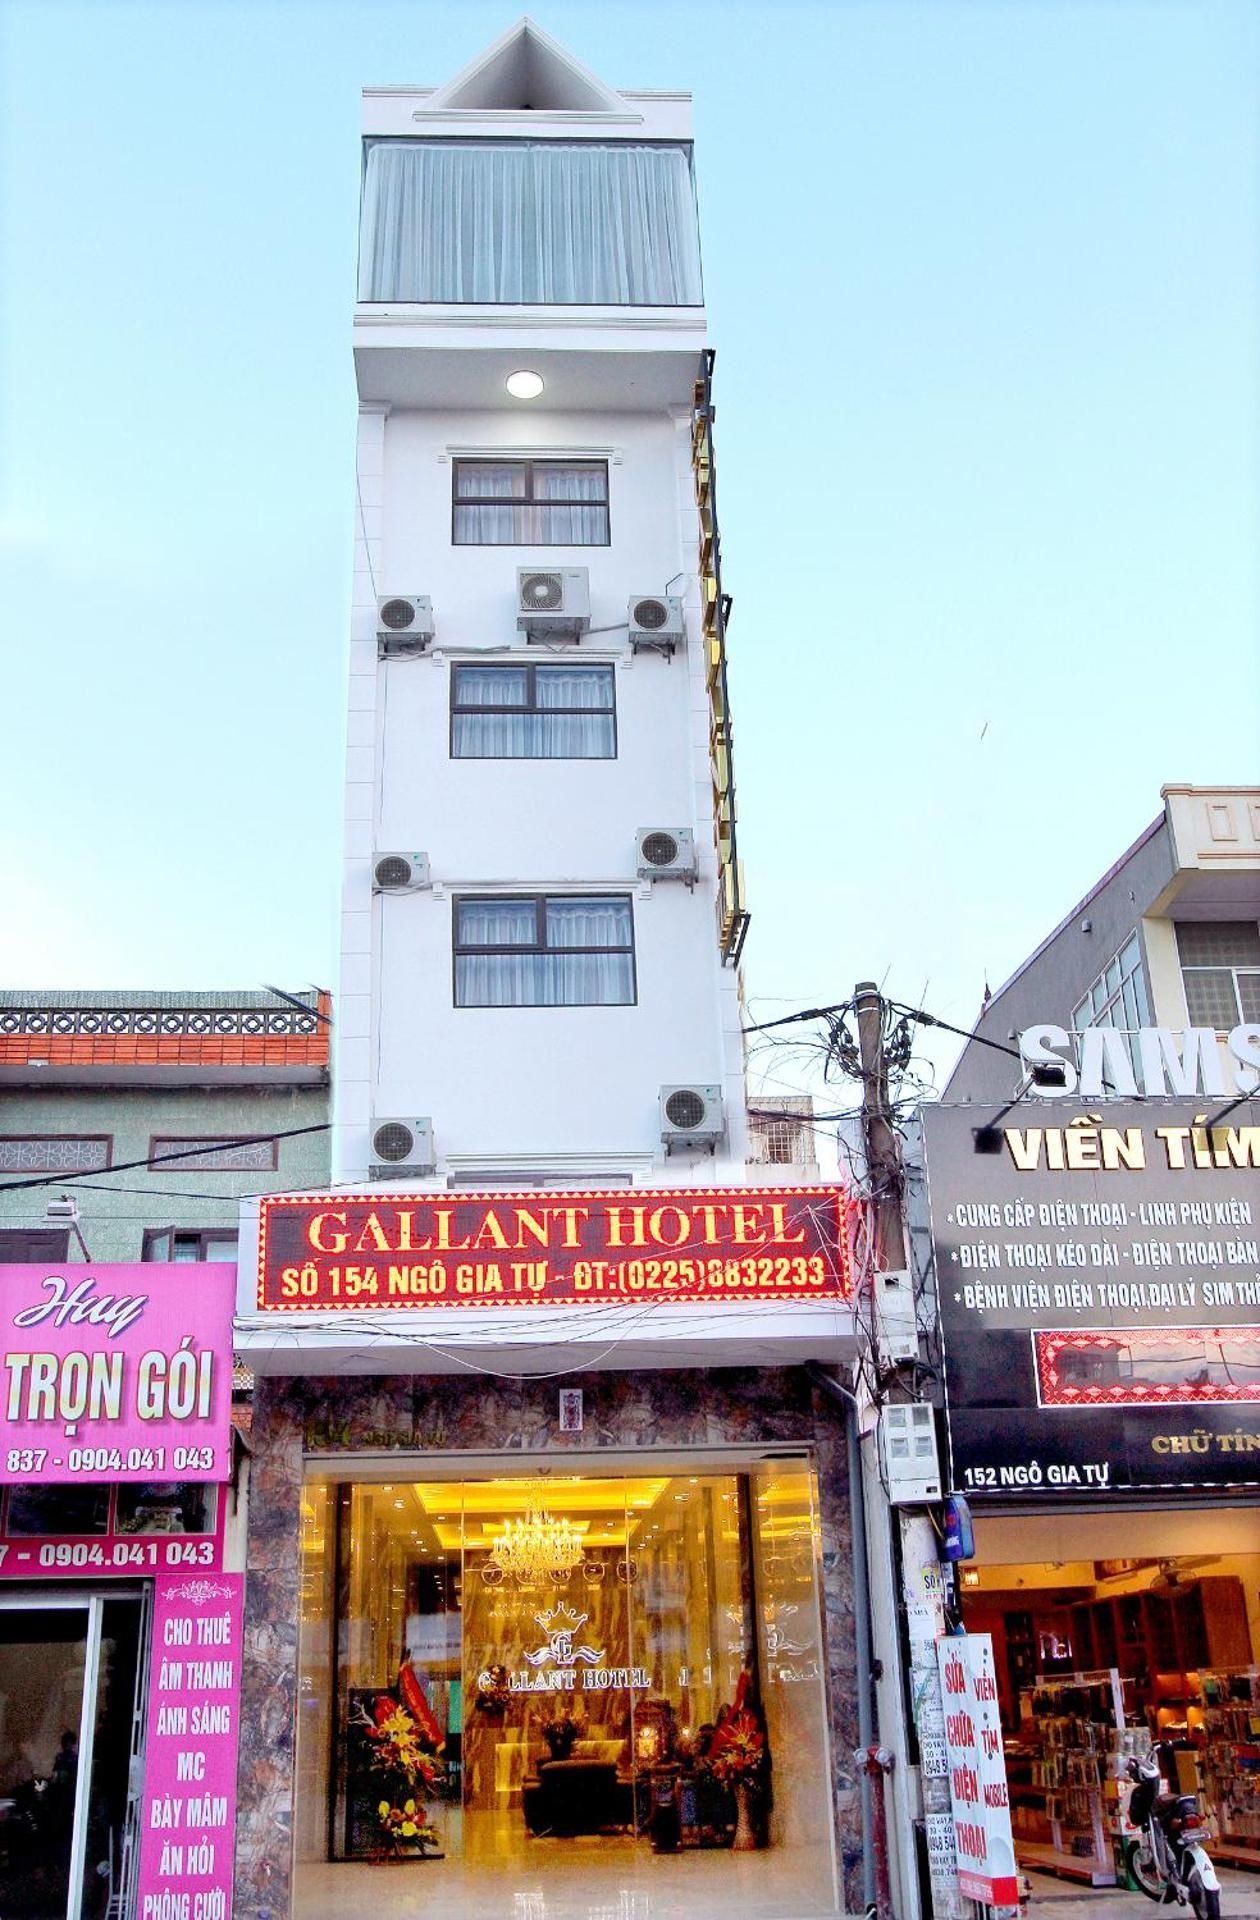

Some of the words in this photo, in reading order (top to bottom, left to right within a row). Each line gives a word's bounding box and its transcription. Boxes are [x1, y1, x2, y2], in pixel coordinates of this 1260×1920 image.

[1003, 1113, 1147, 1171] VIỄN
[307, 1206, 589, 1254] GALLANT
[604, 1202, 806, 1248] HOTEL
[956, 1203, 1001, 1228] CUNG
[1003, 1197, 1035, 1228] CẤP
[1039, 1198, 1078, 1232] ĐIỆN
[1081, 1203, 1128, 1231] THOẠI
[1139, 1202, 1177, 1226] LINH
[1180, 1202, 1212, 1230] PHỤ
[1214, 1197, 1252, 1230] KIỆN
[960, 1239, 1001, 1272] ĐIỆN
[1004, 1243, 1052, 1272] THOẠI
[1056, 1238, 1087, 1267] KÉO
[1090, 1238, 1120, 1267] DÀI
[1132, 1238, 1173, 1271] ĐIỆN
[1176, 1241, 1224, 1270] THOẠI
[1225, 1236, 1260, 1265] BÀN
[280, 1257, 323, 1297] SỐ
[329, 1265, 379, 1296] 154
[388, 1259, 447, 1295] NGÔ
[456, 1263, 504, 1293] GIA
[511, 1260, 548, 1298] TỰ
[13, 1275, 149, 1339] Huy
[963, 1279, 1009, 1314] BỆNH
[1012, 1279, 1051, 1313] VIỆN
[1054, 1279, 1094, 1313] ĐIỆN
[1202, 1281, 1236, 1306] SIM
[5, 1349, 125, 1438] TRỌN
[136, 1335, 215, 1421] GÓI
[1151, 1427, 1213, 1454] CHỮ
[7, 1448, 48, 1473] 837
[68, 1447, 166, 1472] 0904.041
[173, 1446, 214, 1470] 043
[964, 1467, 997, 1486] 152
[1000, 1460, 1043, 1485] NGÔ
[1046, 1465, 1081, 1484] GIA
[1083, 1461, 1109, 1487] TỰ
[39, 1543, 158, 1567] 0904.041
[166, 1541, 215, 1566] 043
[163, 1617, 193, 1646] CHO
[197, 1610, 232, 1645] THUÊ
[158, 1655, 183, 1691] ÂM
[186, 1660, 233, 1691] THANH
[583, 1666, 652, 1689] HOTEL
[156, 1700, 188, 1736] ÁNH
[190, 1699, 231, 1736] SÁNG
[176, 1751, 206, 1782] MC
[150, 1792, 183, 1829] BÀY
[186, 1791, 228, 1828] MÂM
[159, 1838, 184, 1877] ĂN
[186, 1834, 216, 1876] HỎI
[142, 1886, 191, 1920] PHÔNG
[193, 1884, 227, 1920] CƯỚI
